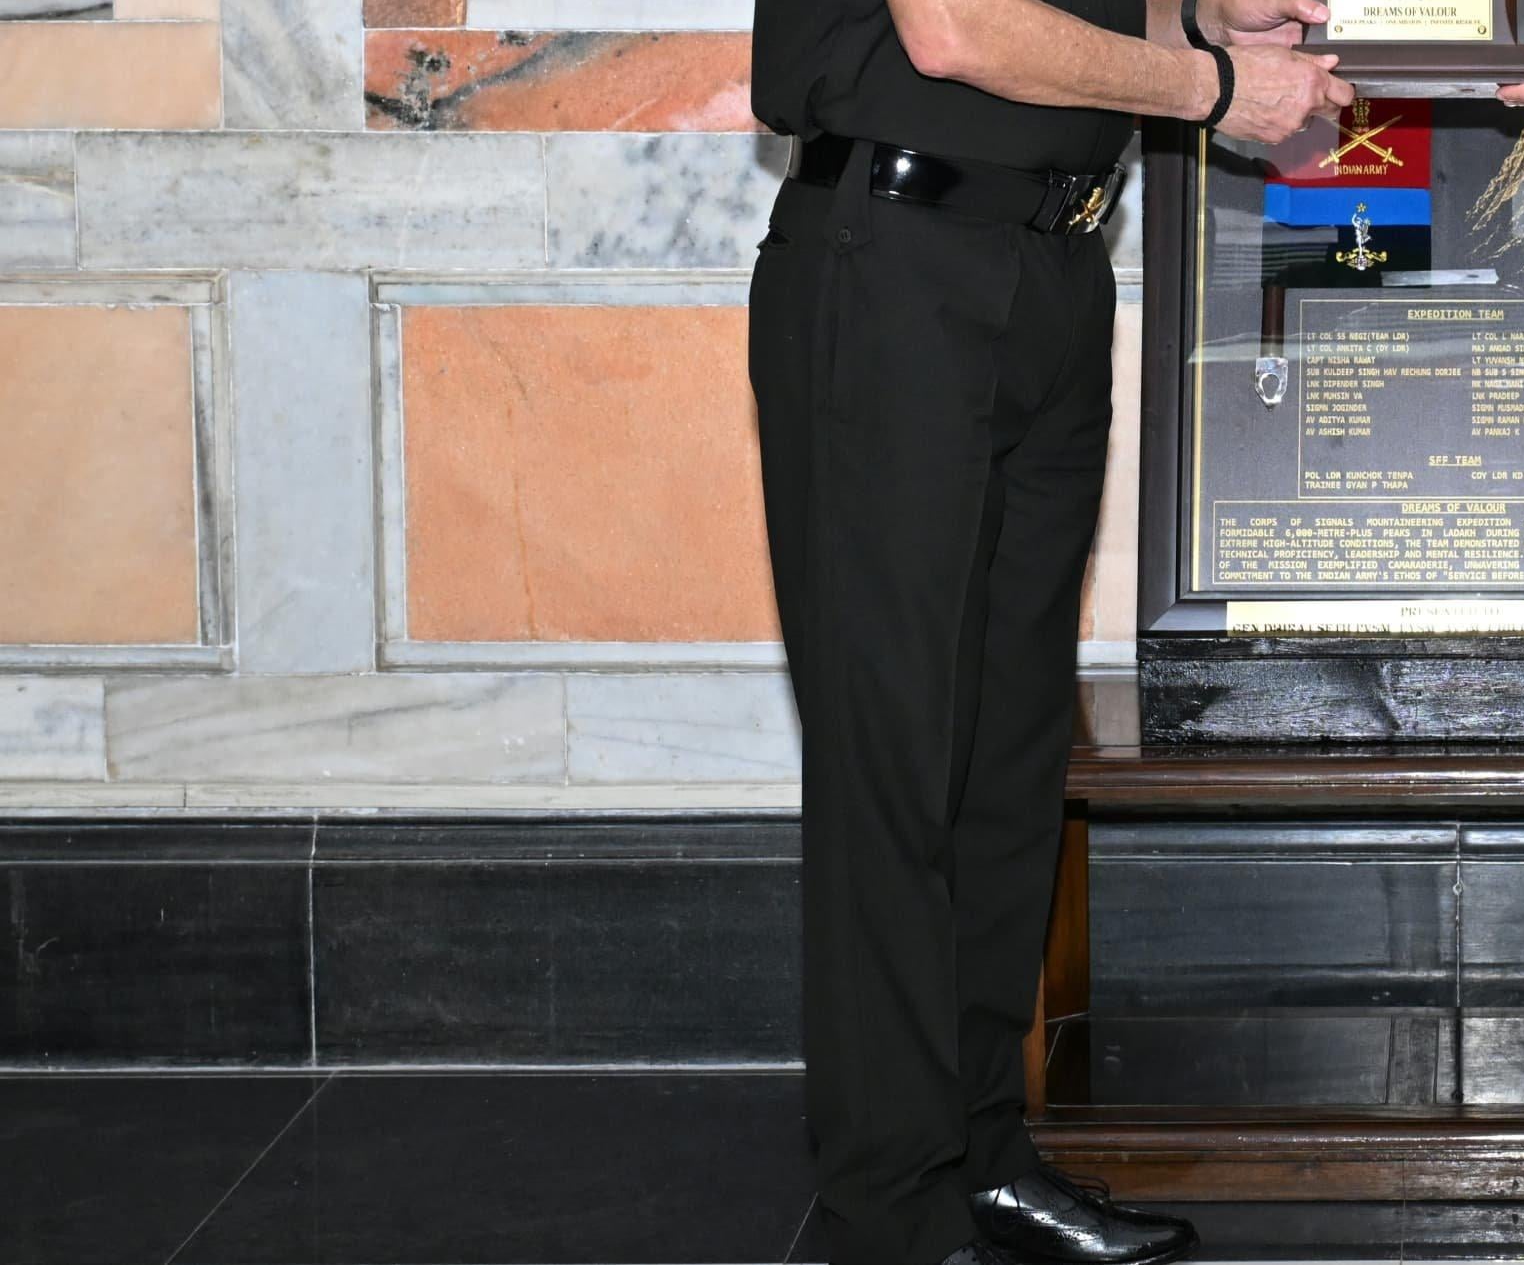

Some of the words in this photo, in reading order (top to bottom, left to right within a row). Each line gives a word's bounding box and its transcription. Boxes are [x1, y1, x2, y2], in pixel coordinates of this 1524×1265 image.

[1363, 6, 1403, 17] DREAMS
[1404, 6, 1418, 17] OF
[1419, 6, 1457, 17] VALOUR
[1408, 309, 1472, 318] EXPEDITION
[1479, 309, 1504, 318] TEAM
[1455, 455, 1481, 464] TEAM
[1402, 503, 1440, 512] DREAMS
[1447, 503, 1460, 512] OF
[1467, 503, 1505, 512] VALOUR
[1220, 518, 1236, 527] THE
[1250, 518, 1277, 527] CORPS
[1290, 518, 1301, 527] OF
[1315, 518, 1353, 527] SIGNALS
[1367, 518, 1443, 527] MOUNTAINEERING
[1457, 518, 1511, 527] EXPEDITION
[1220, 528, 1274, 537] FORMIDABLE
[1383, 528, 1410, 537] PEAKS
[1422, 528, 1432, 537] IN
[1444, 528, 1476, 537] LADAKH
[1486, 528, 1519, 537] DURING
[1220, 539, 1257, 548] EXTREME
[1264, 539, 1333, 548] HIGH-ALTITUDE
[1340, 539, 1398, 549] CONDITIONS,
[1406, 539, 1421, 548] THE
[1426, 539, 1448, 548] TEAM
[1454, 539, 1519, 548] DEMONSTRATED
[1220, 550, 1268, 559] TECHNICAL
[1274, 550, 1338, 560] PROFICIENCY,
[1346, 550, 1399, 559] LEADERSHIP
[1405, 550, 1421, 559] AND
[1426, 550, 1458, 559] MENTAL
[1465, 550, 1523, 559] RESILIENCE.
[1219, 561, 1230, 570] OF
[1242, 561, 1258, 570] THE
[1268, 561, 1307, 570] MISSION
[1318, 561, 1378, 570] EXEMPLIFIED
[1464, 561, 1519, 570] UNWAVERING
[1220, 571, 1273, 580] COMMITMENT
[1280, 571, 1290, 580] TO
[1296, 571, 1312, 580] THE
[1318, 571, 1350, 580] INDIAN
[1394, 571, 1421, 580] ETHOS
[1426, 571, 1437, 580] OF
[1492, 571, 1524, 580] BEFORE
